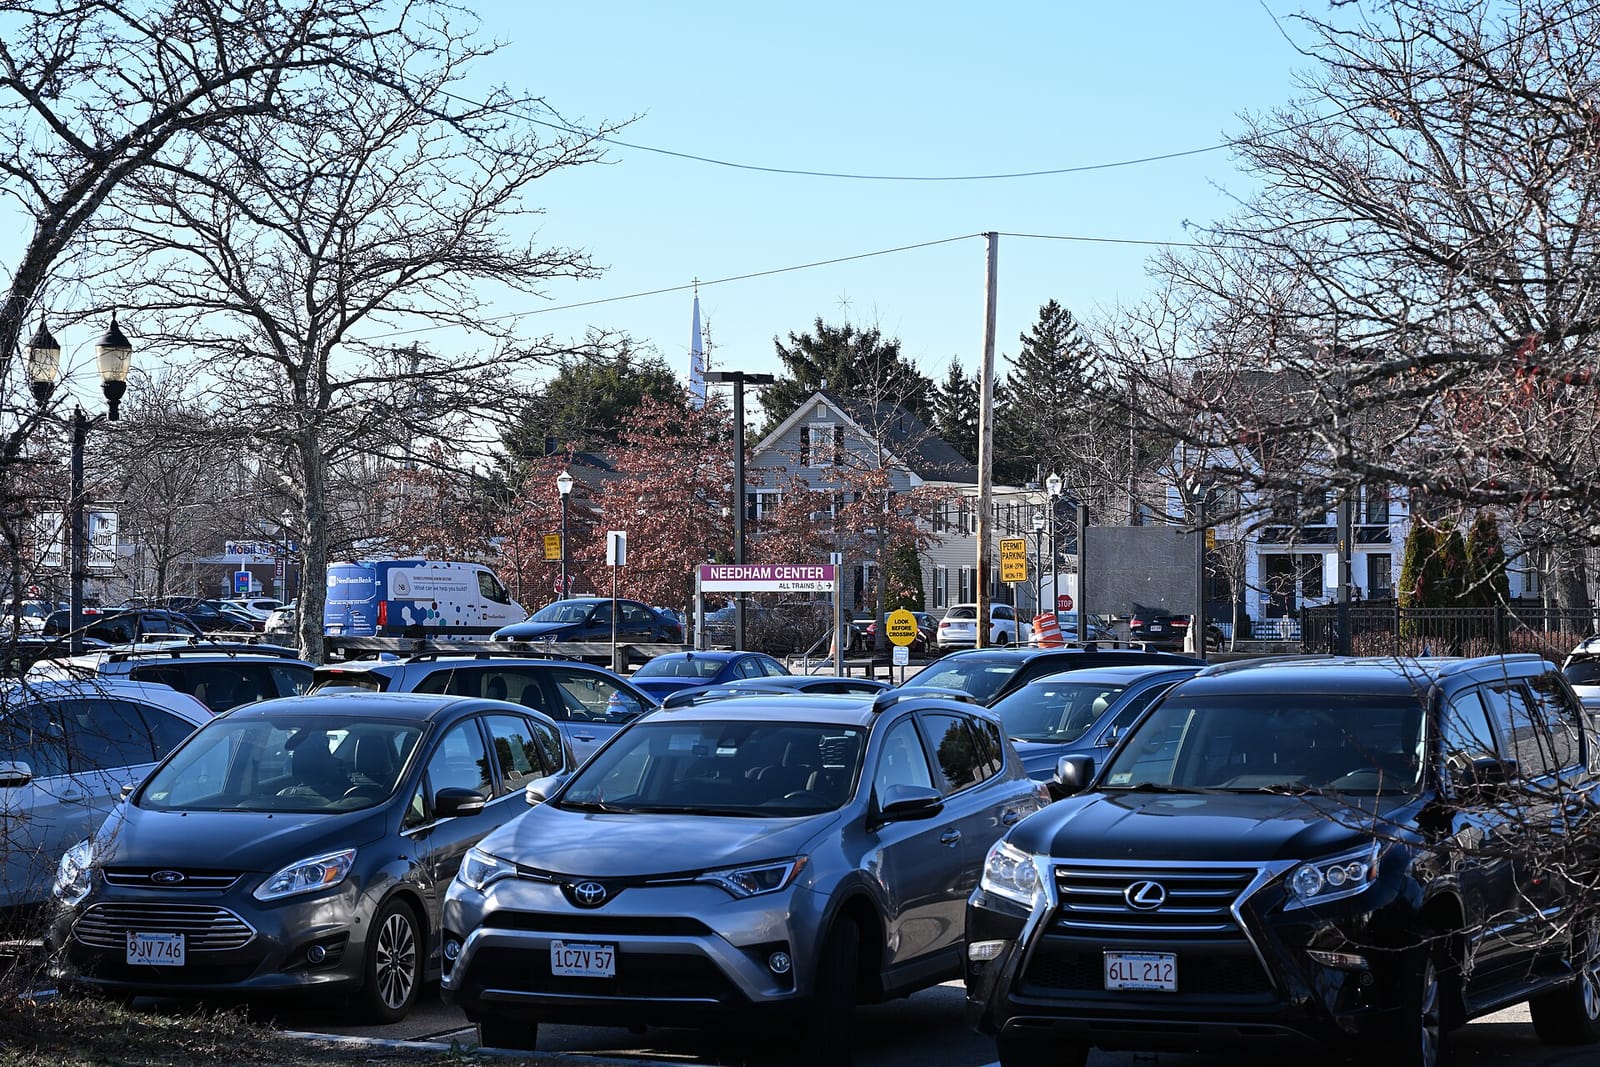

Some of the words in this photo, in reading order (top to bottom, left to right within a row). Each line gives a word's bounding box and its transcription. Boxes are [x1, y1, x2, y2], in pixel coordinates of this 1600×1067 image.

[228, 544, 256, 555] Mobil
[1003, 542, 1023, 550] PERMIT
[1002, 552, 1025, 560] PARKING
[711, 567, 771, 579] NEEDHAM
[775, 567, 824, 579] CENTER
[129, 941, 153, 958] 9JV
[157, 941, 181, 958] 746
[555, 950, 591, 968] 1CZV
[594, 951, 613, 969] 57
[1109, 962, 1139, 981] 6LL
[1143, 962, 1173, 982] 212
